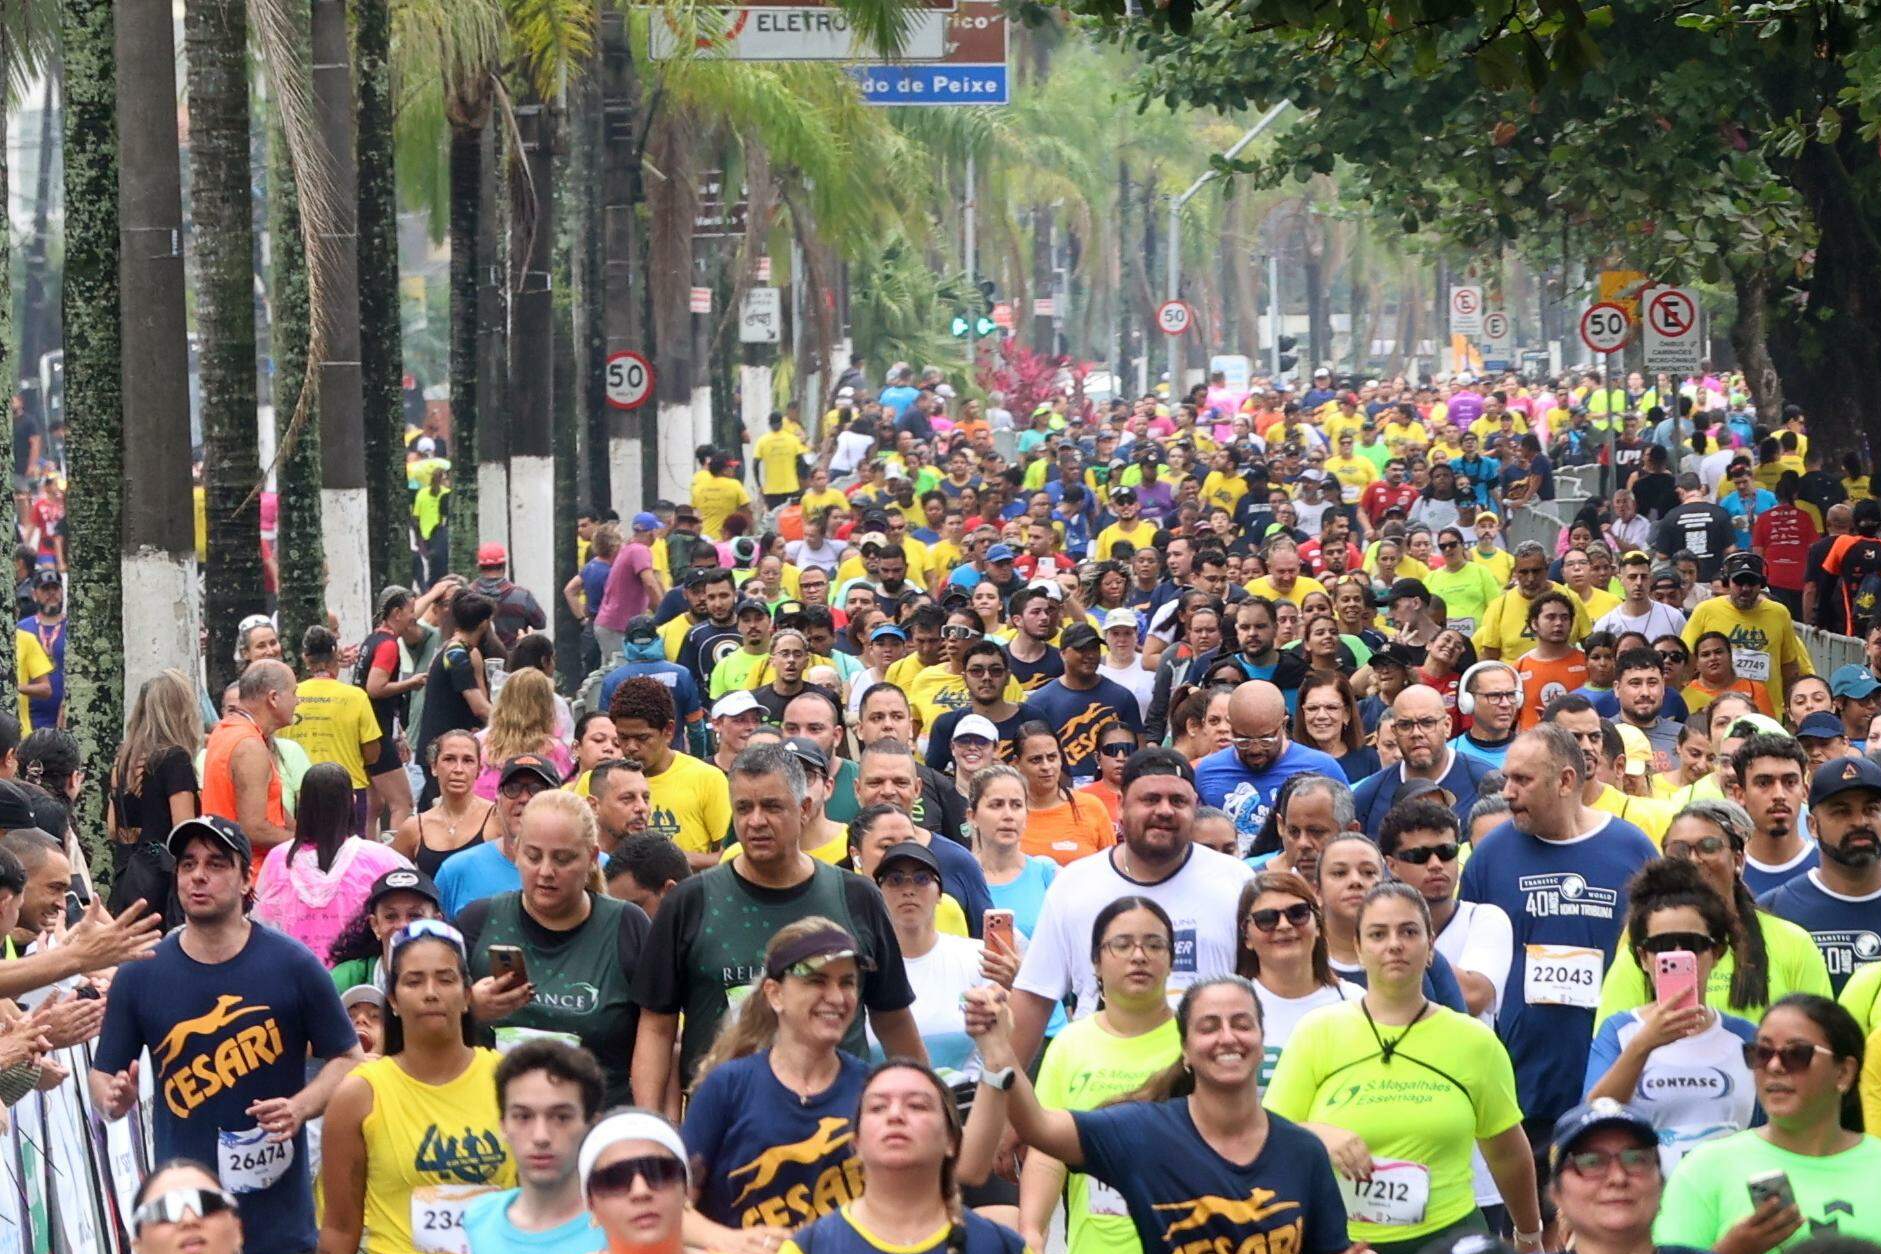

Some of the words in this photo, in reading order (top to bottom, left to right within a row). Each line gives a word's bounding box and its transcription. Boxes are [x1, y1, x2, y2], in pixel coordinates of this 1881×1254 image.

[896, 75, 924, 93] de
[932, 74, 998, 93] Peixe
[1164, 309, 1185, 322] 50
[1590, 313, 1623, 336] 50
[608, 364, 643, 388] 50
[1736, 658, 1766, 670] 27749
[1525, 890, 1549, 918] 40
[1533, 966, 1593, 986] 22043
[229, 1142, 286, 1171] 26474
[1355, 1180, 1409, 1202] 17212
